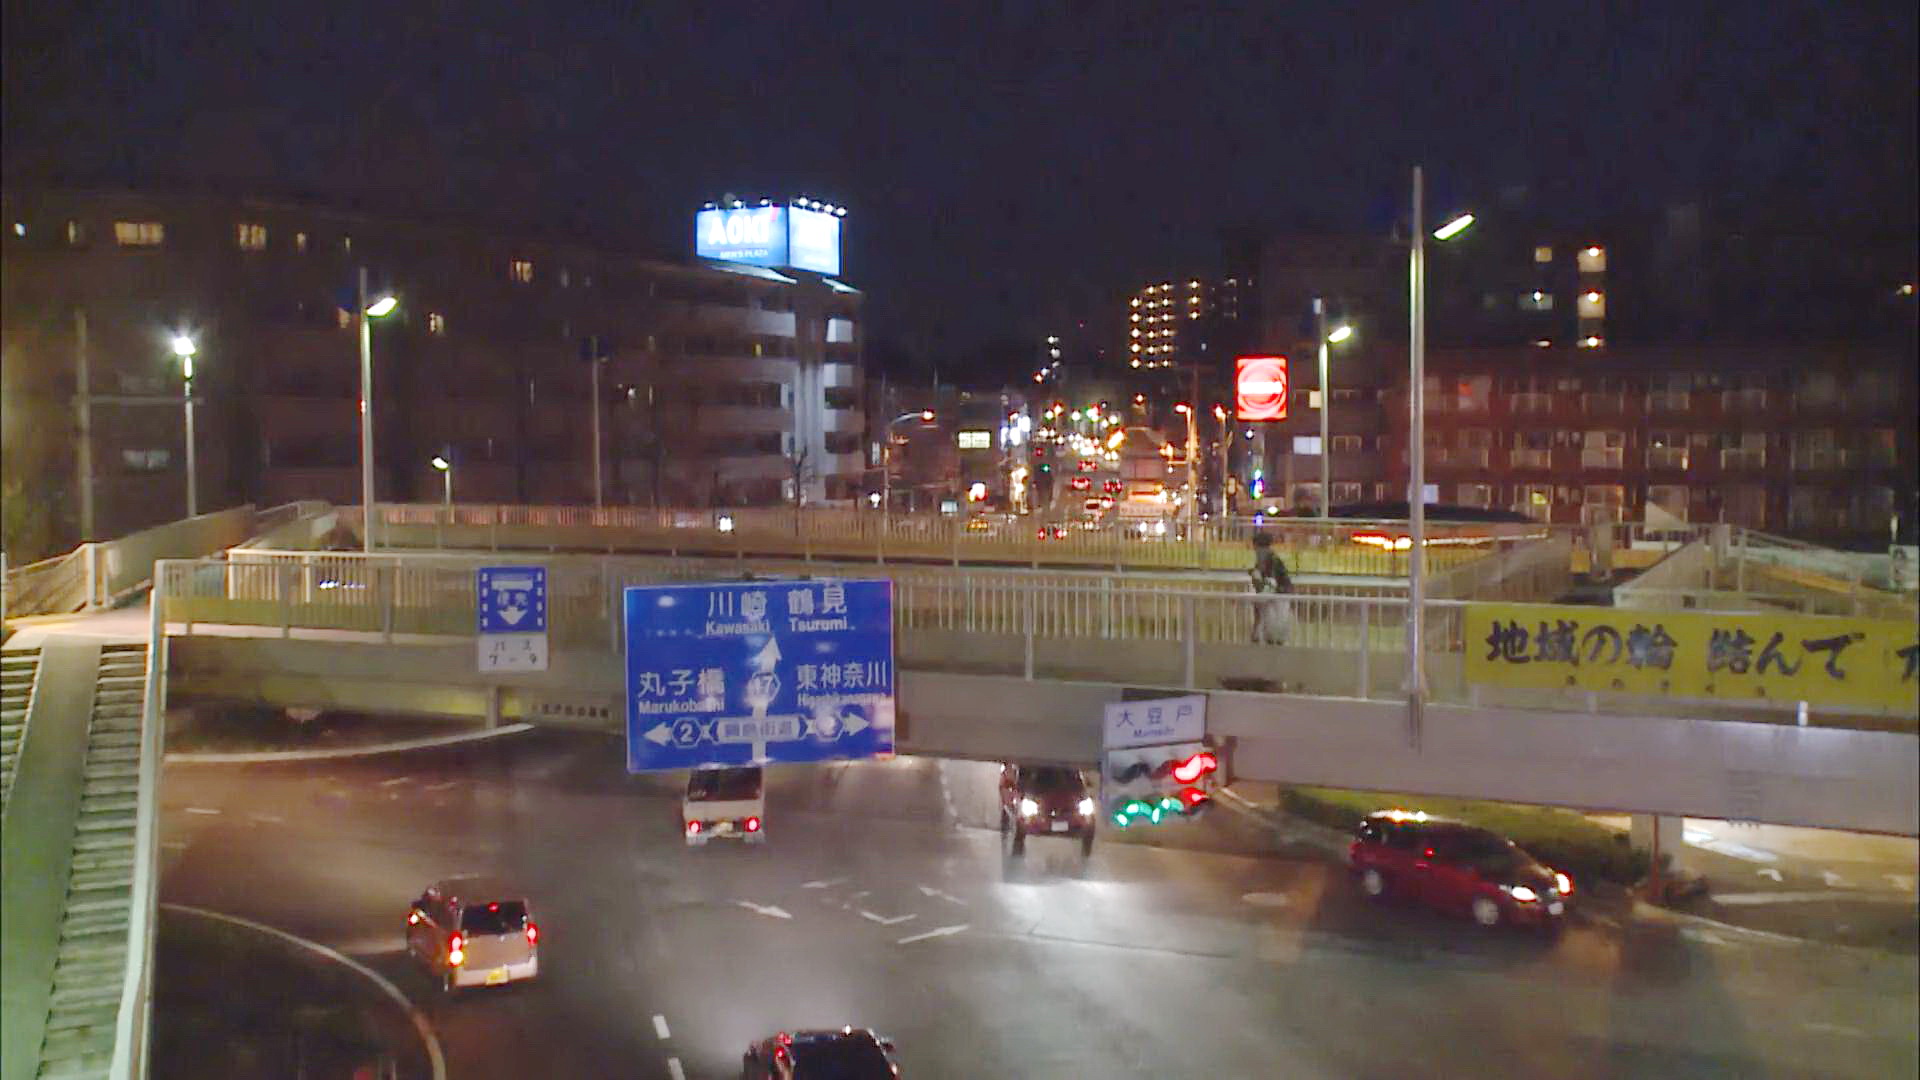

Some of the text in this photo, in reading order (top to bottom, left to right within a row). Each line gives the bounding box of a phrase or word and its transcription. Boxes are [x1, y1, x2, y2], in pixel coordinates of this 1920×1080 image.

[707, 591, 767, 617] 川崎
[705, 616, 848, 635] Kawasaki Tsurumi
[1486, 619, 1678, 671] 地域の輪
[637, 667, 725, 698] 丸子橋
[797, 661, 887, 690] 東神奈川
[1116, 704, 1193, 728] 大豆戸
[680, 723, 693, 742] 2
